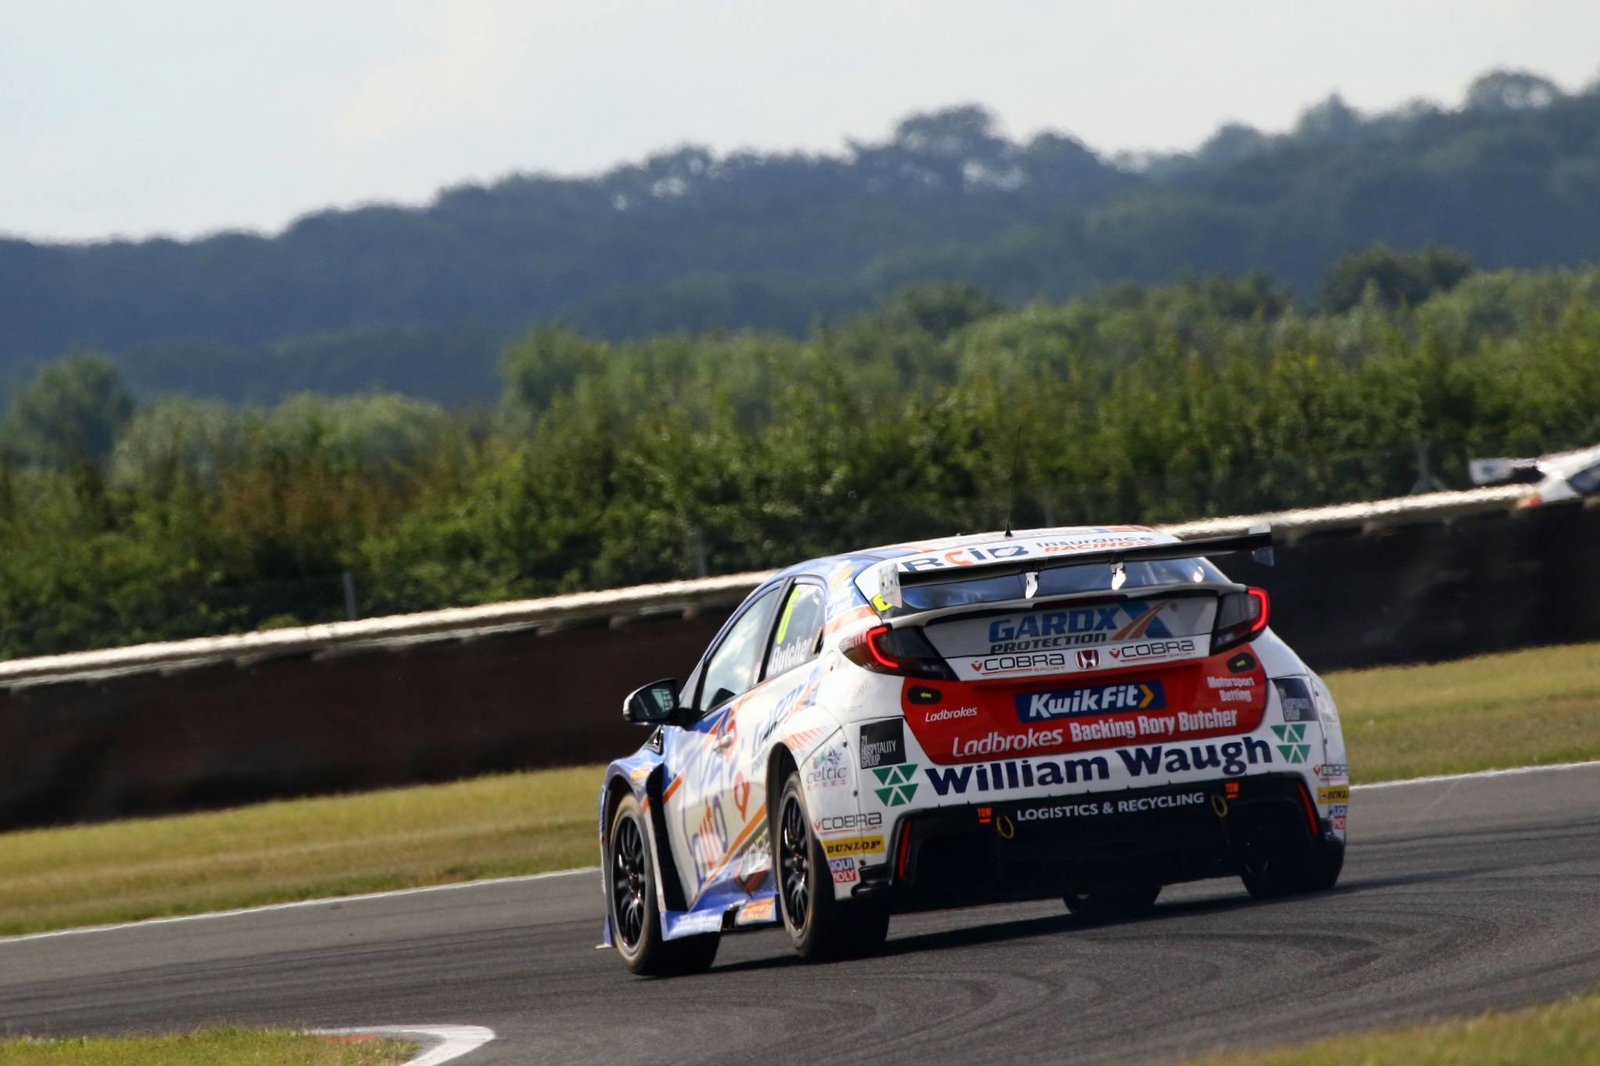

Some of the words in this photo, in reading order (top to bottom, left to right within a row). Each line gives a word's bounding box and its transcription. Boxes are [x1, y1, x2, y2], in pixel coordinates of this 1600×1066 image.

[1044, 541, 1134, 553] RACING
[990, 633, 1106, 653] PROTECTION
[1207, 676, 1255, 688] Motorsport
[1219, 689, 1252, 702] Betting
[924, 706, 978, 723] Ladbrokes
[952, 727, 1064, 758] Ladbrokes
[1070, 719, 1137, 743] Backing
[1138, 713, 1176, 736] Rory
[1178, 708, 1238, 732] Butcher
[925, 756, 1111, 796] William
[1115, 736, 1274, 777] Waugh
[1017, 802, 1099, 821] LOGISTICS
[1102, 801, 1114, 814] &
[1118, 792, 1206, 812] RECYCLING
[826, 839, 881, 854] DUNLOP
